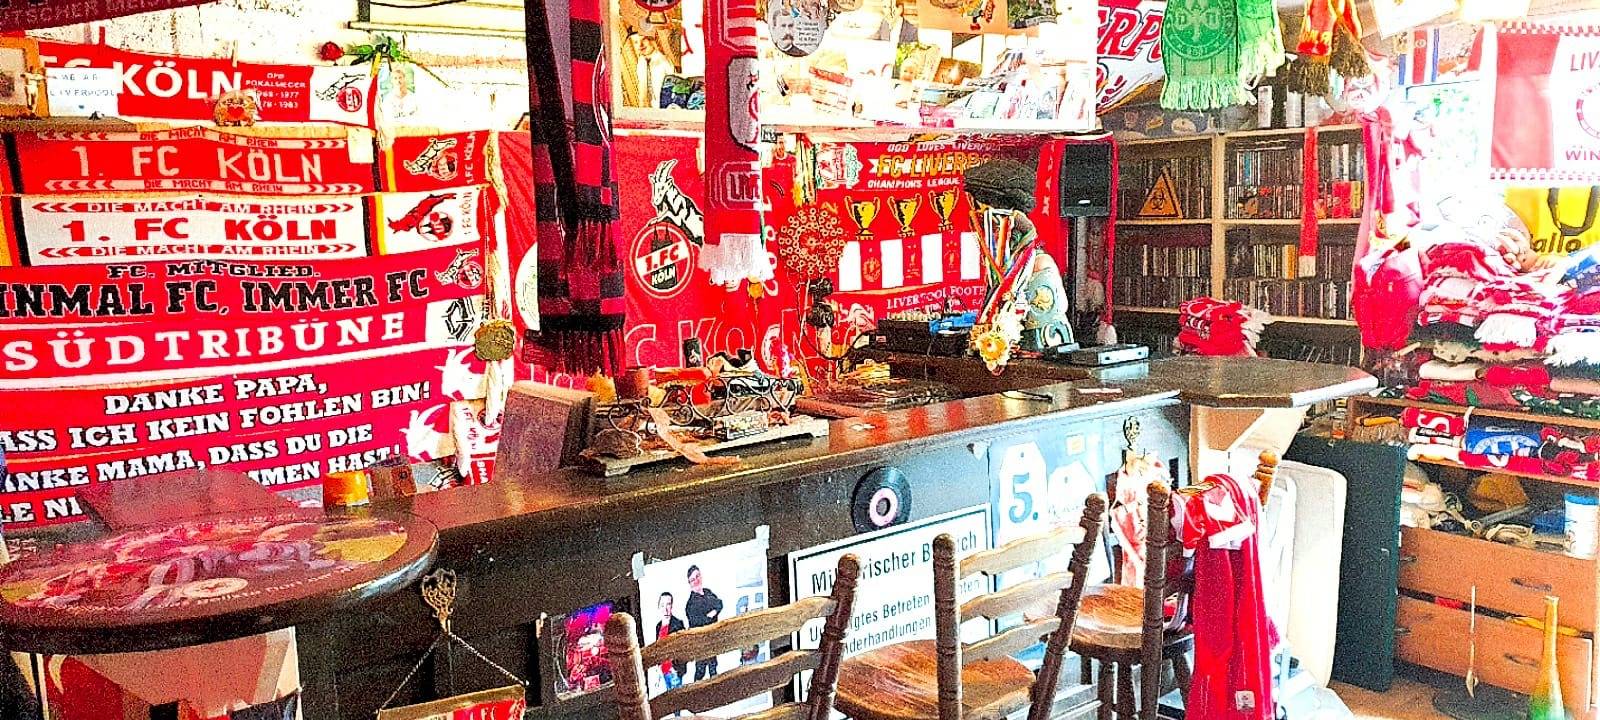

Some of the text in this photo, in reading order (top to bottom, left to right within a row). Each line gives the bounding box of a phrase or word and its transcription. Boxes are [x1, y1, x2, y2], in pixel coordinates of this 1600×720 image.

[1097, 9, 1163, 58] RP
[1570, 50, 1600, 71] LIV
[113, 60, 242, 100] KÖLN
[72, 145, 322, 182] 1. FC KÖLN
[877, 154, 906, 178] FC
[1566, 150, 1600, 161] WIN
[867, 178, 960, 189] CHAMPIONS LEAGUE
[87, 199, 317, 214] DIE MACHT AM RHEIN
[62, 214, 337, 242] 1. FC KÖLN
[91, 244, 319, 256] DIE MACHT AM RHEIN
[1530, 233, 1582, 253] allo
[107, 260, 322, 279] FC. MITGLIED.
[645, 245, 679, 272] 1.FC
[652, 265, 676, 286] KÖLN
[0, 269, 429, 317] INMAL FC, IMMER FC
[2, 312, 405, 372] SÜDTRIBÜNE
[104, 373, 328, 414] DANKE PAPA,
[0, 381, 431, 452] ASS ICH KEIN FOHLEN BIN!
[3, 424, 372, 493] ANKE MAMA, DASS DU DIE
[1009, 472, 1039, 523] 5.
[812, 552, 916, 594] Milrischer
[883, 594, 930, 618] Betreten
